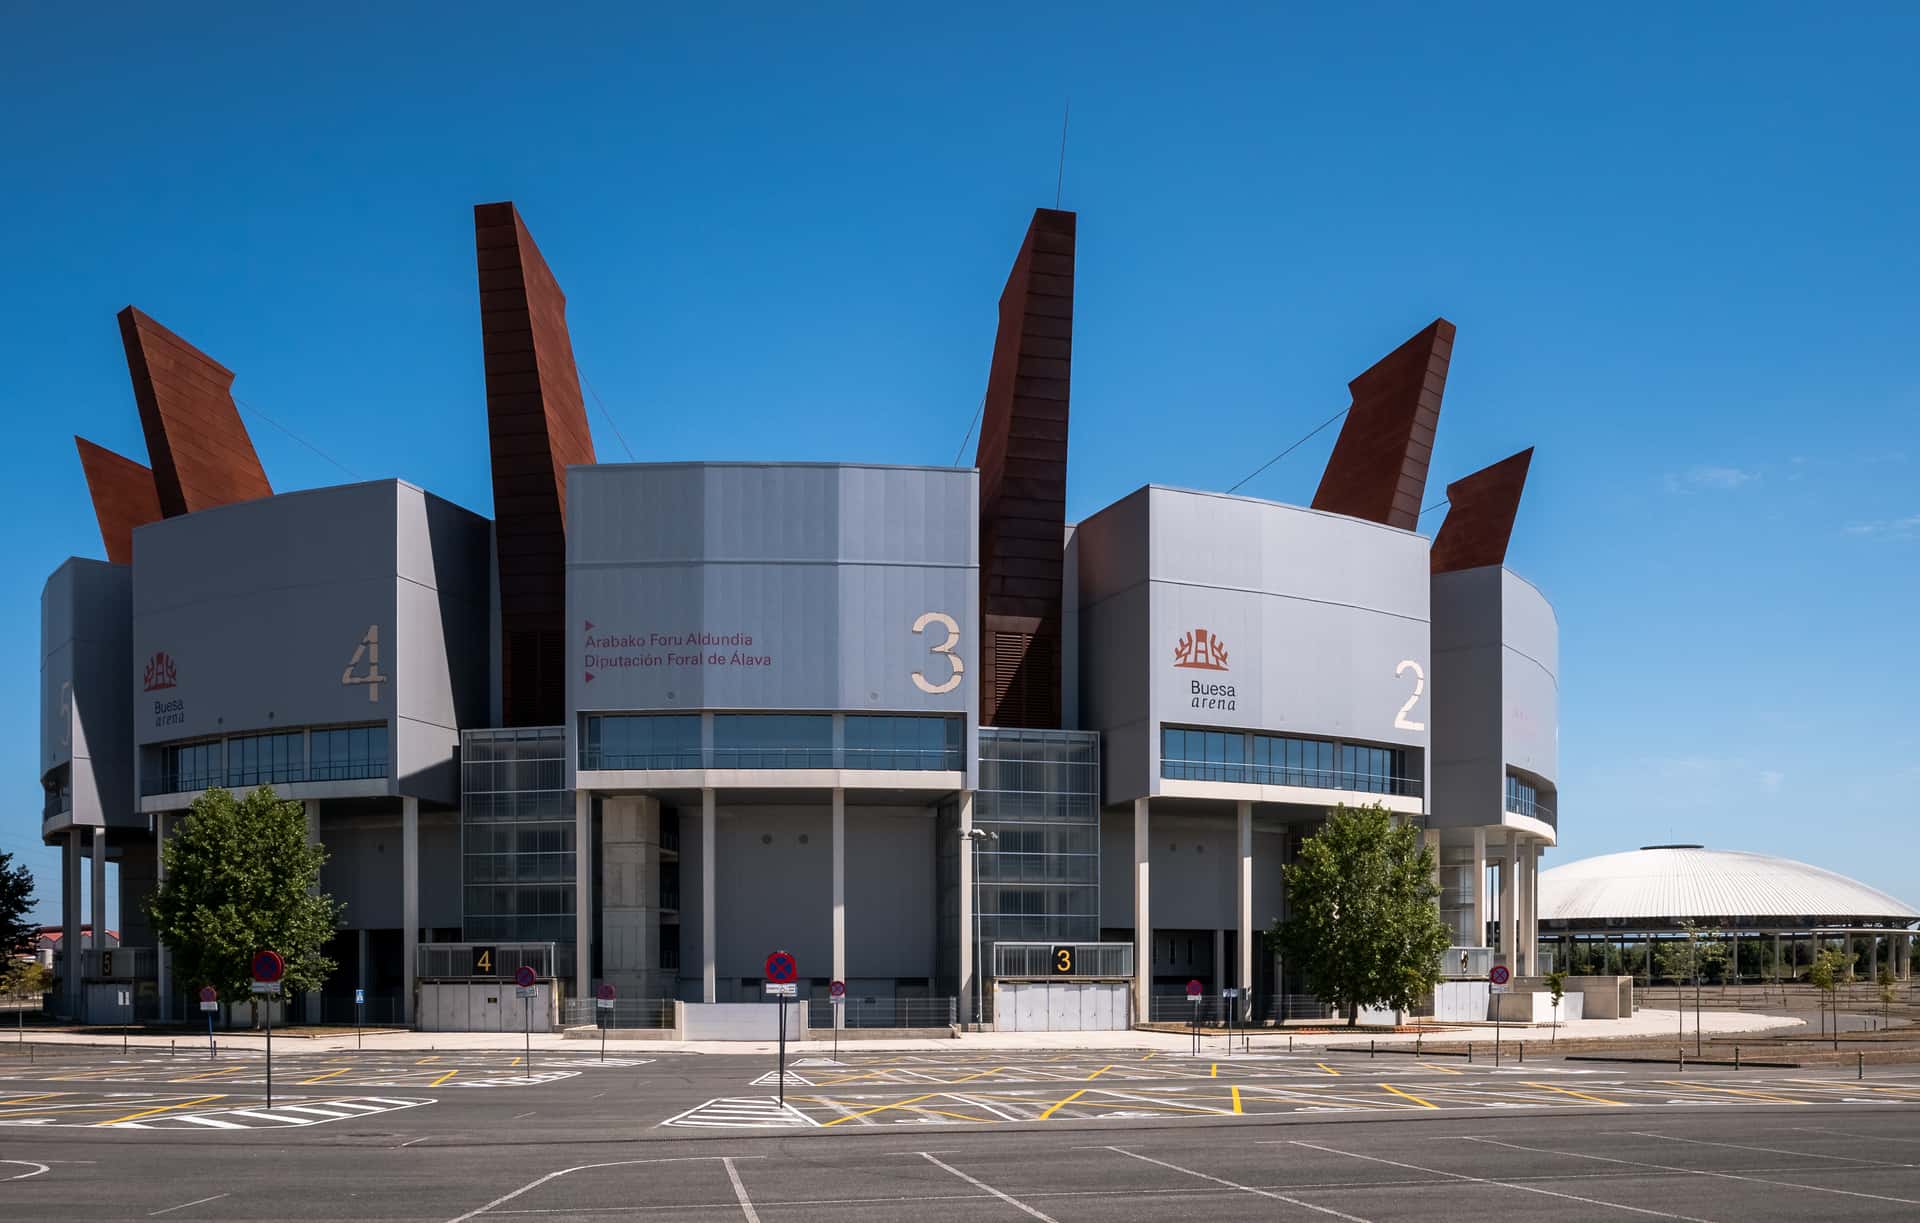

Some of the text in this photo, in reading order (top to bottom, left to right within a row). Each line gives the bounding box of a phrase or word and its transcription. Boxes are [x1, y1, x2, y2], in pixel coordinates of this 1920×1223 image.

[585, 632, 753, 648] Arabako Foru Aldundia
[585, 651, 771, 670] Diputación Foral de Álava
[911, 612, 963, 694] 3
[342, 625, 387, 702] 4
[1191, 680, 1236, 696] Buesa
[1394, 659, 1424, 731] 2
[154, 699, 184, 714] Buesa
[1192, 696, 1236, 711] arena
[155, 712, 184, 727] arena
[103, 954, 111, 973] 5
[477, 950, 491, 971] 4
[1057, 949, 1071, 972] 3
